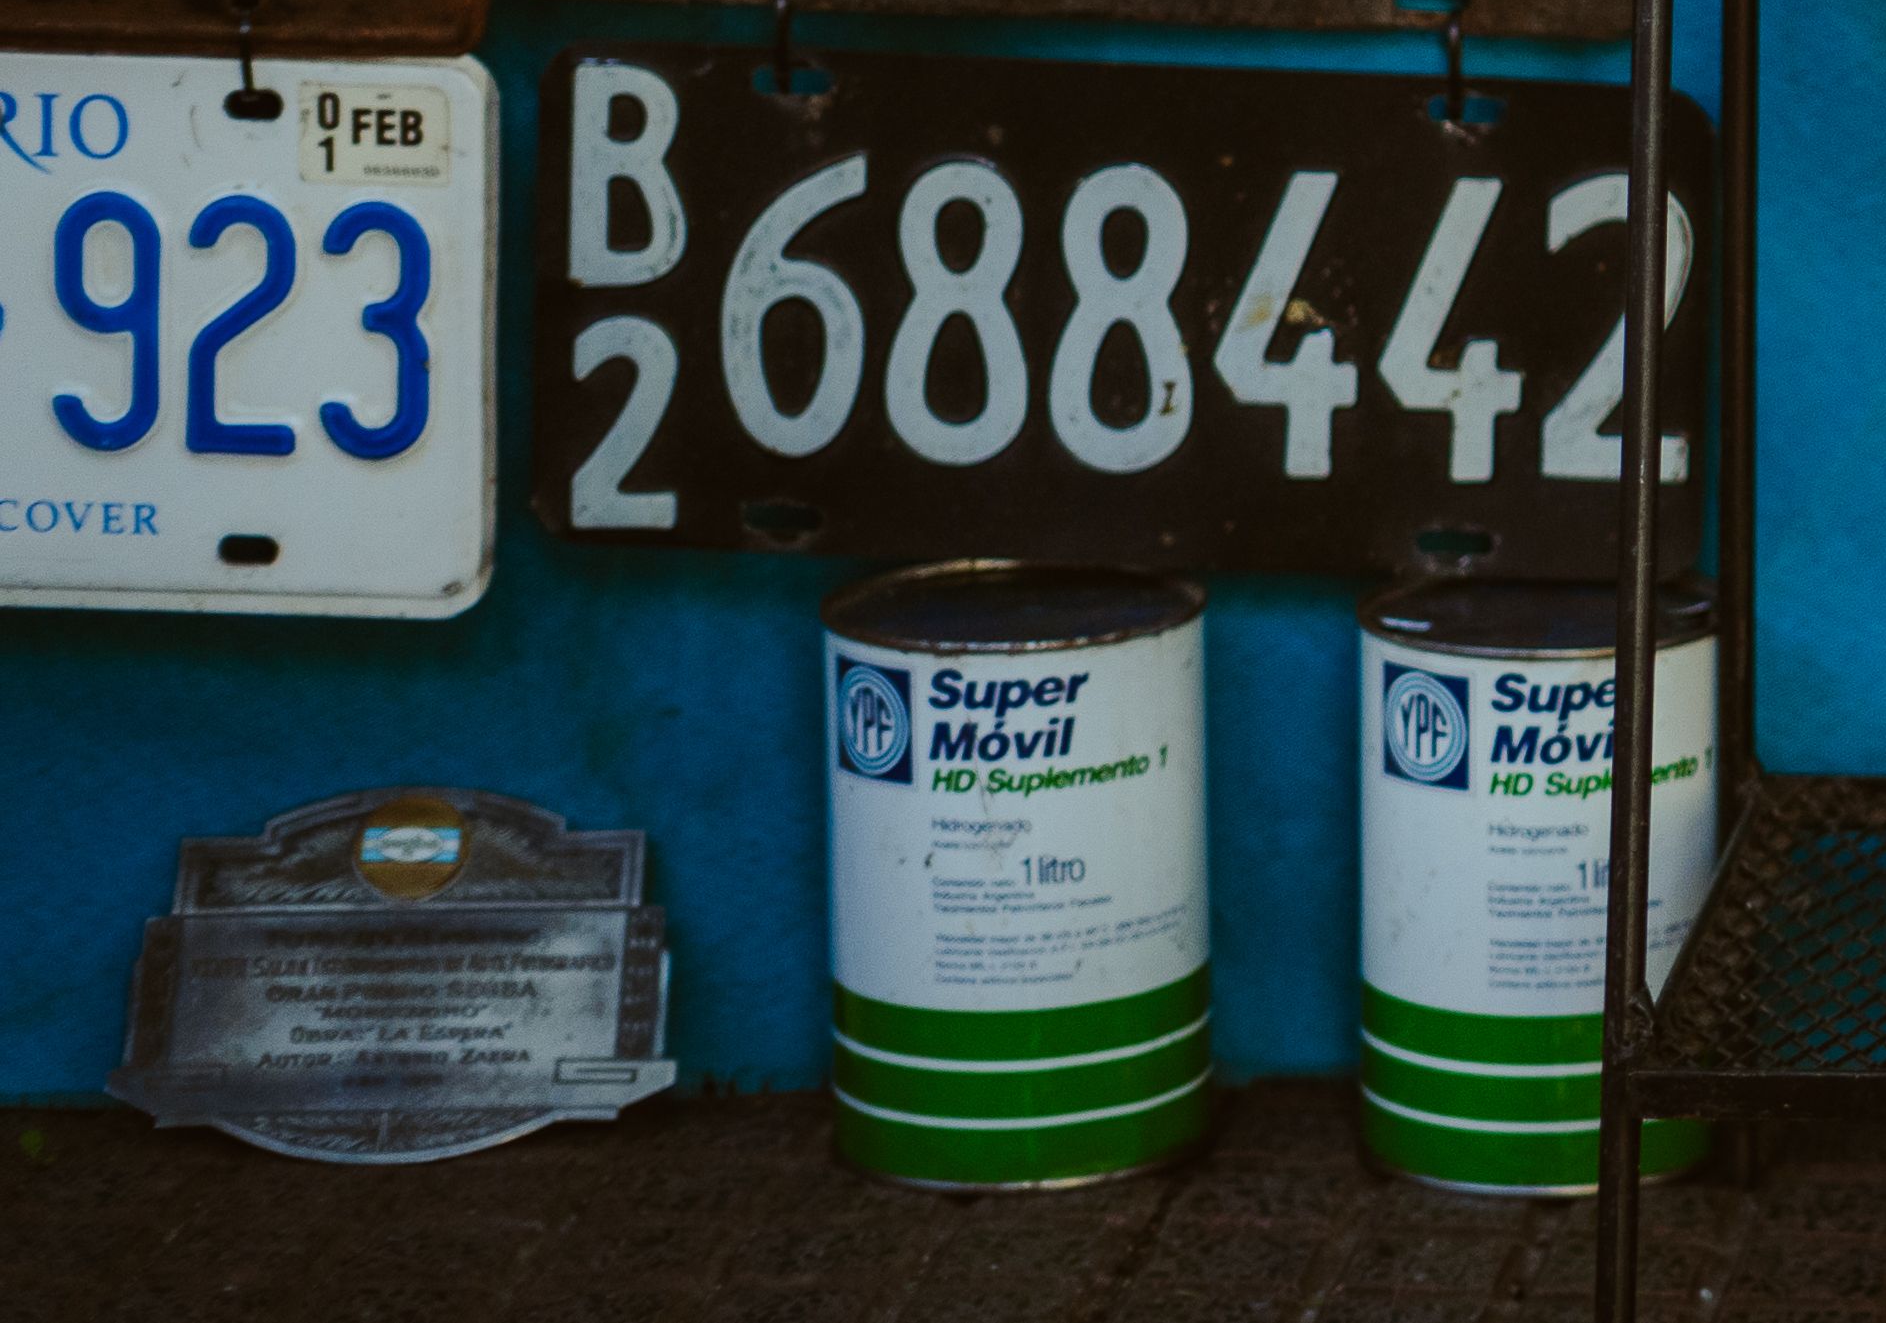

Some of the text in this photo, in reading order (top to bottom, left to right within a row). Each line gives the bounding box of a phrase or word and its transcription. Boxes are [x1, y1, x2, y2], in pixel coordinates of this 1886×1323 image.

[351, 108, 425, 147] FEB
[52, 190, 433, 461] 923
[720, 154, 1693, 484] 688442
[928, 668, 1090, 718] Super
[1491, 673, 1616, 722] Supe
[928, 716, 1077, 761] Móvil
[1490, 721, 1615, 765] Móvi
[931, 744, 1169, 798] HD Suplemento 1
[1489, 772, 1534, 796] HD
[1545, 755, 1699, 801] Suplento
[1022, 855, 1087, 886] 1 litro
